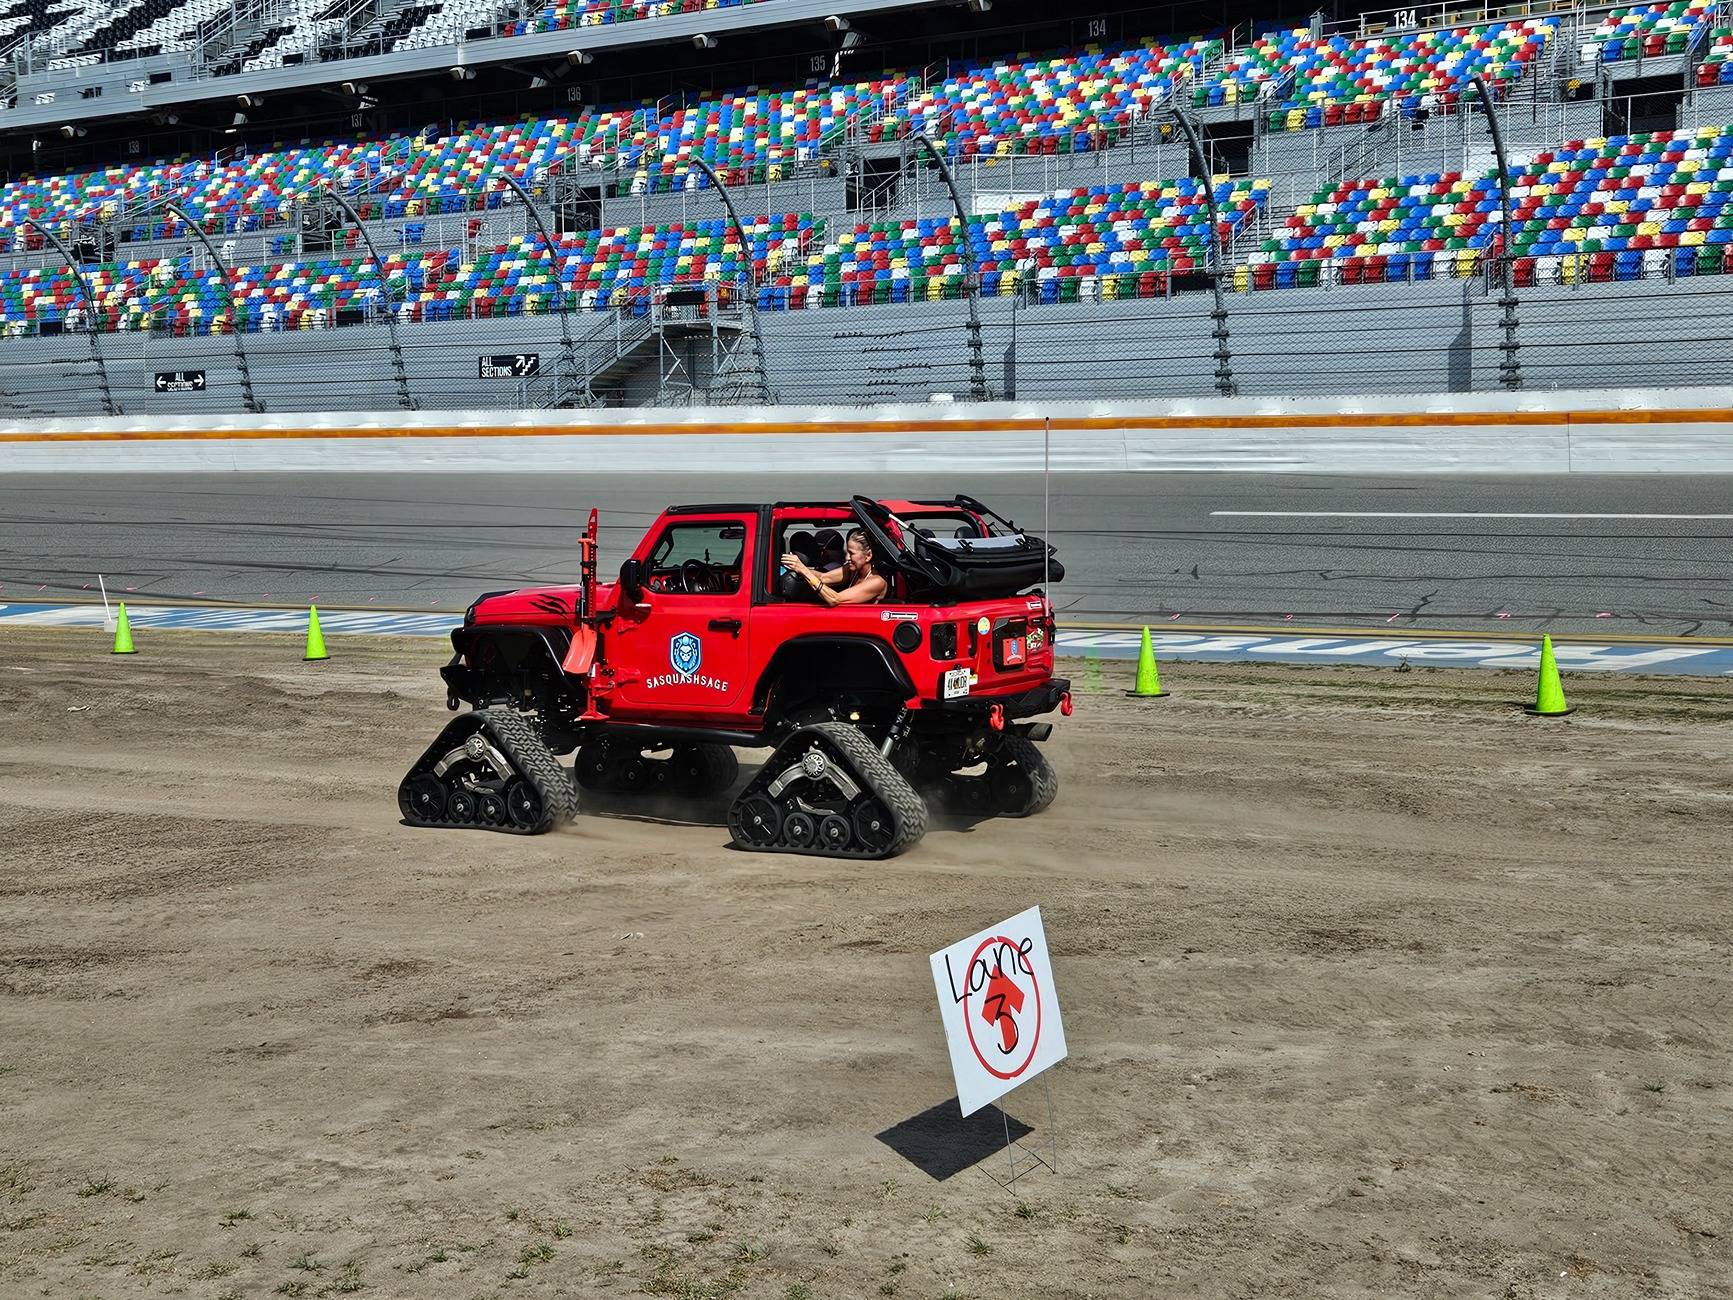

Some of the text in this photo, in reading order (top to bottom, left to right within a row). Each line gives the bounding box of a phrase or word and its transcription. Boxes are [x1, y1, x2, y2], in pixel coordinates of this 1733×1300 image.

[1088, 19, 1106, 37] 134
[1394, 9, 1417, 30] 134
[810, 55, 826, 72] 135
[567, 86, 582, 102] 136
[481, 356, 494, 367] ALL
[481, 365, 513, 378] SECTIONS
[646, 673, 729, 692] SASQUASHSAGE
[944, 937, 1033, 1004] Lane
[984, 993, 1020, 1055] 3
